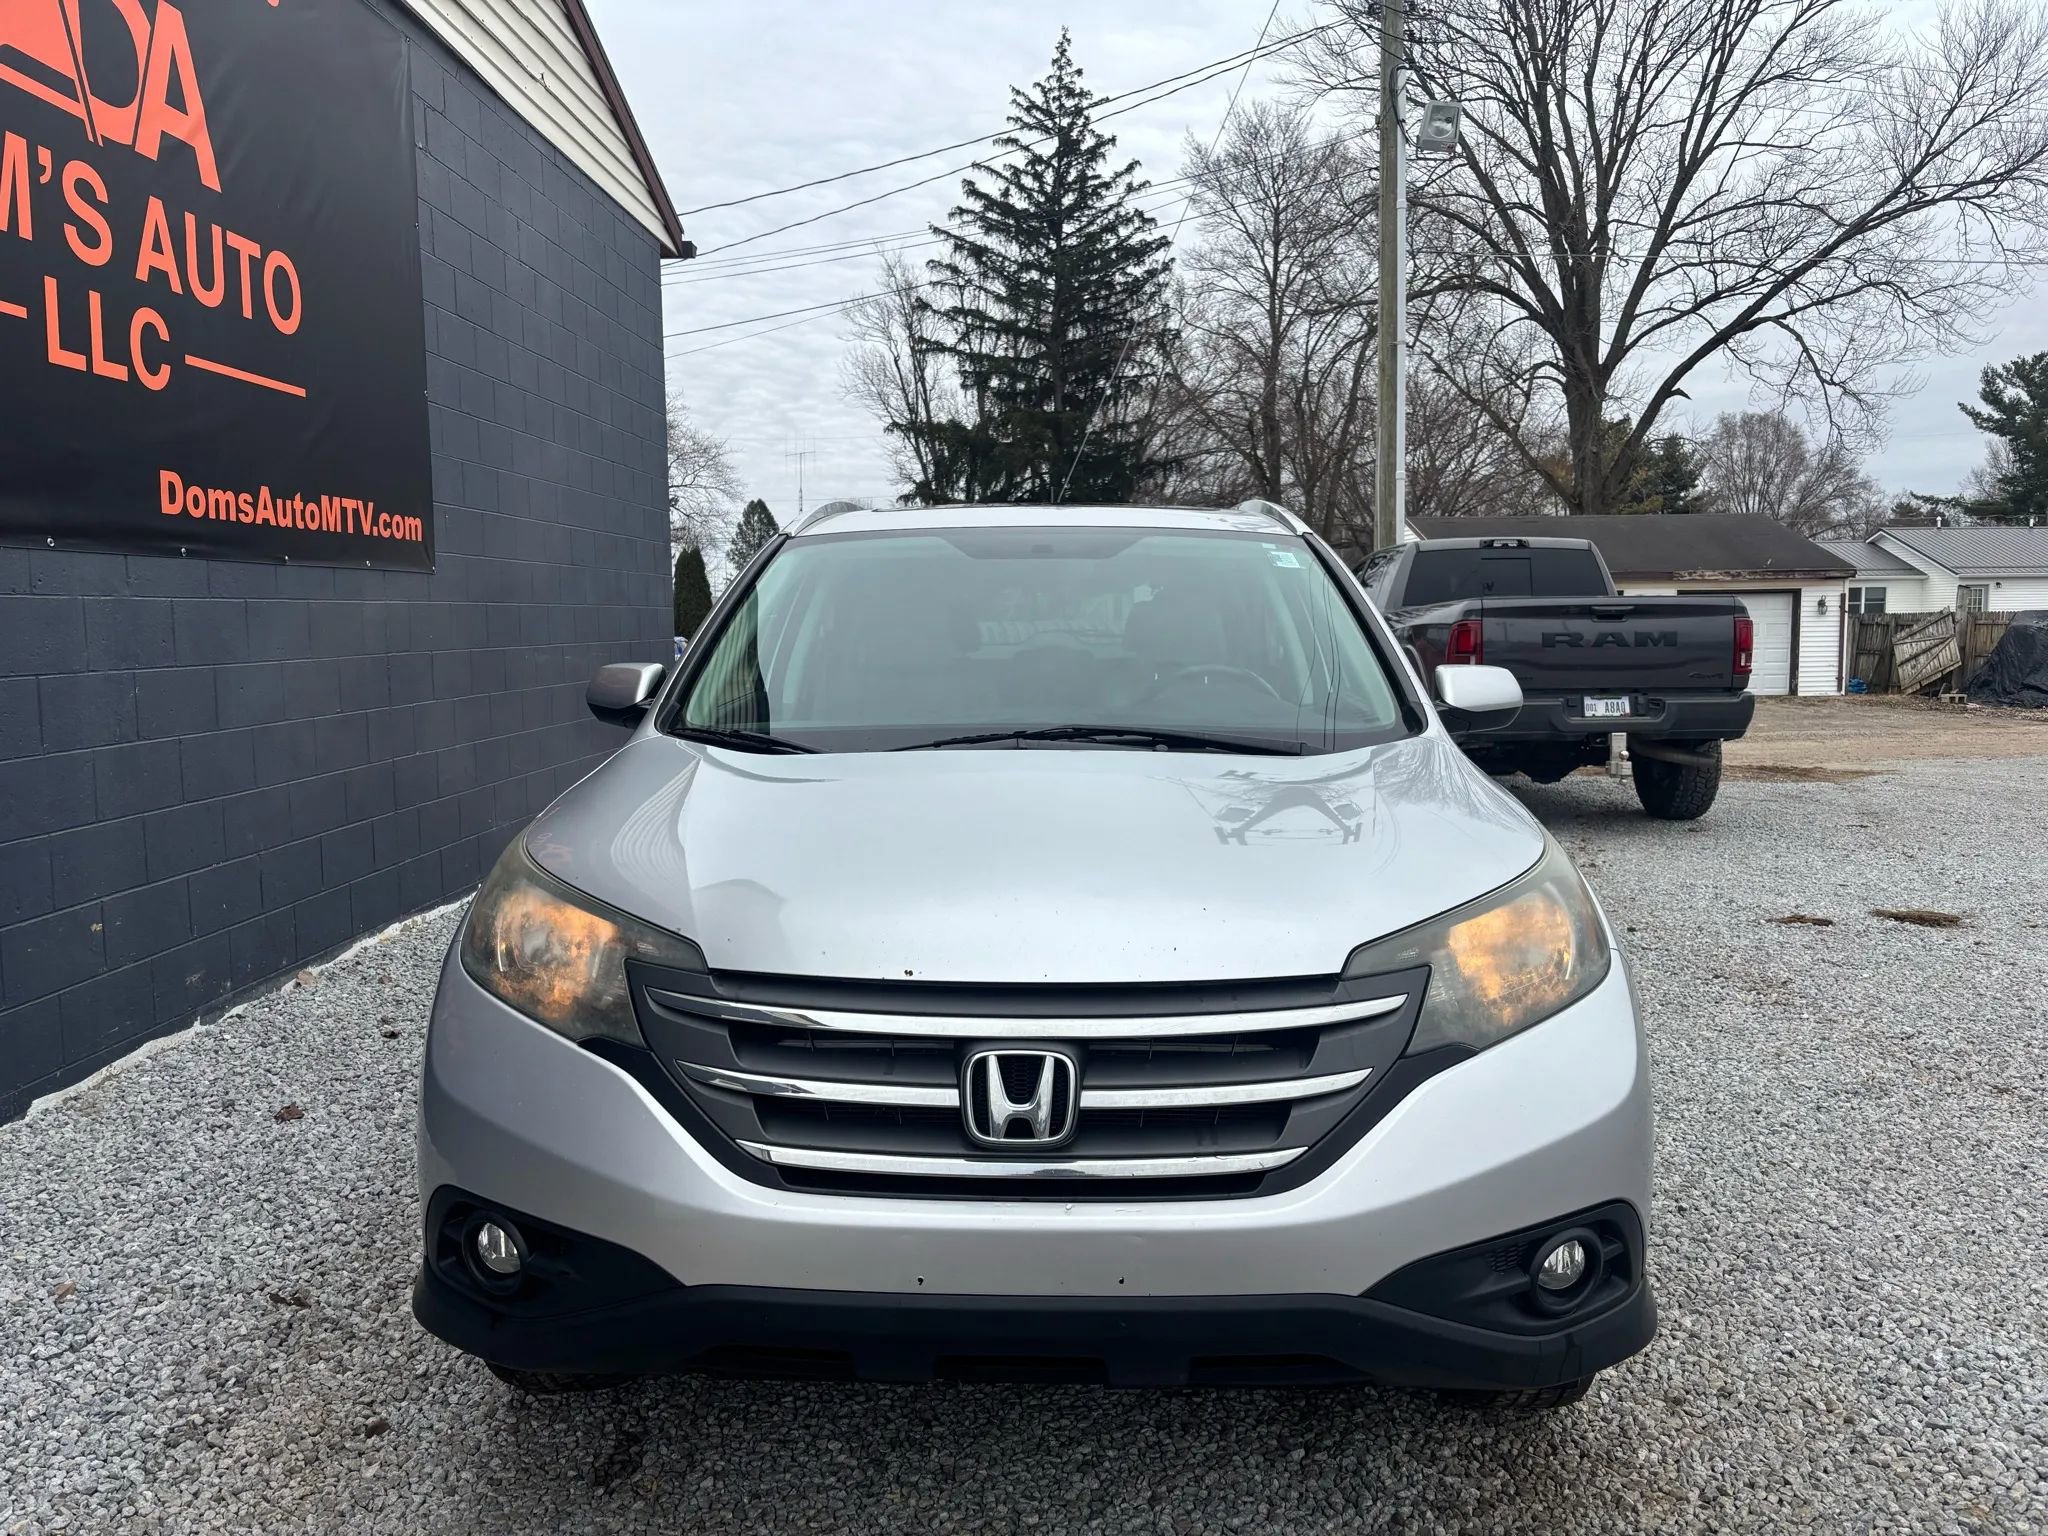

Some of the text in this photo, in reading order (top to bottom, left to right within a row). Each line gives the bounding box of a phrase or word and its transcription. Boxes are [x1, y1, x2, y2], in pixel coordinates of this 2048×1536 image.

[135, 195, 302, 335] AUTO
[44, 275, 171, 391] LLC
[159, 469, 423, 542] DomsAutoMTV.com
[1541, 631, 1678, 648] RAM
